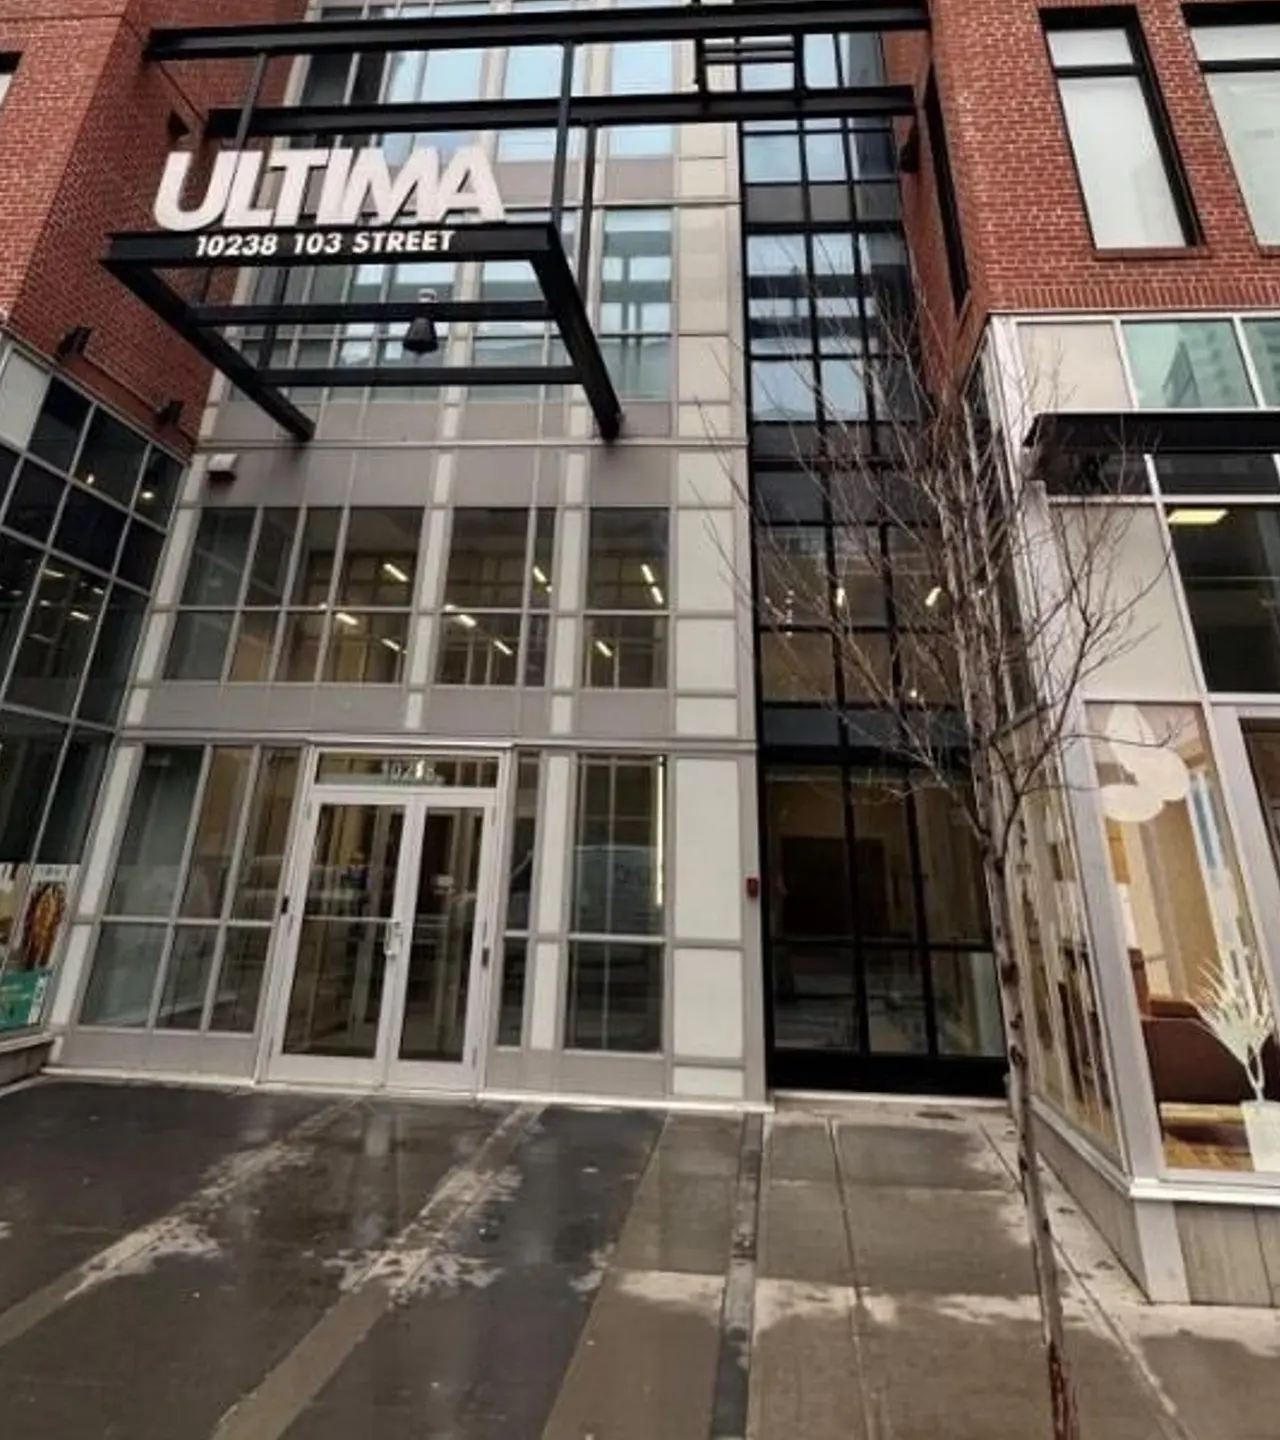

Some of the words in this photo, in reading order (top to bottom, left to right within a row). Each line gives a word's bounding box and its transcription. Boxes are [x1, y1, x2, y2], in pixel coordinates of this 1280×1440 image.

[154, 145, 506, 231] ULTIMA
[195, 233, 278, 257] 10238
[294, 232, 342, 255] 103
[352, 229, 456, 254] STREET
